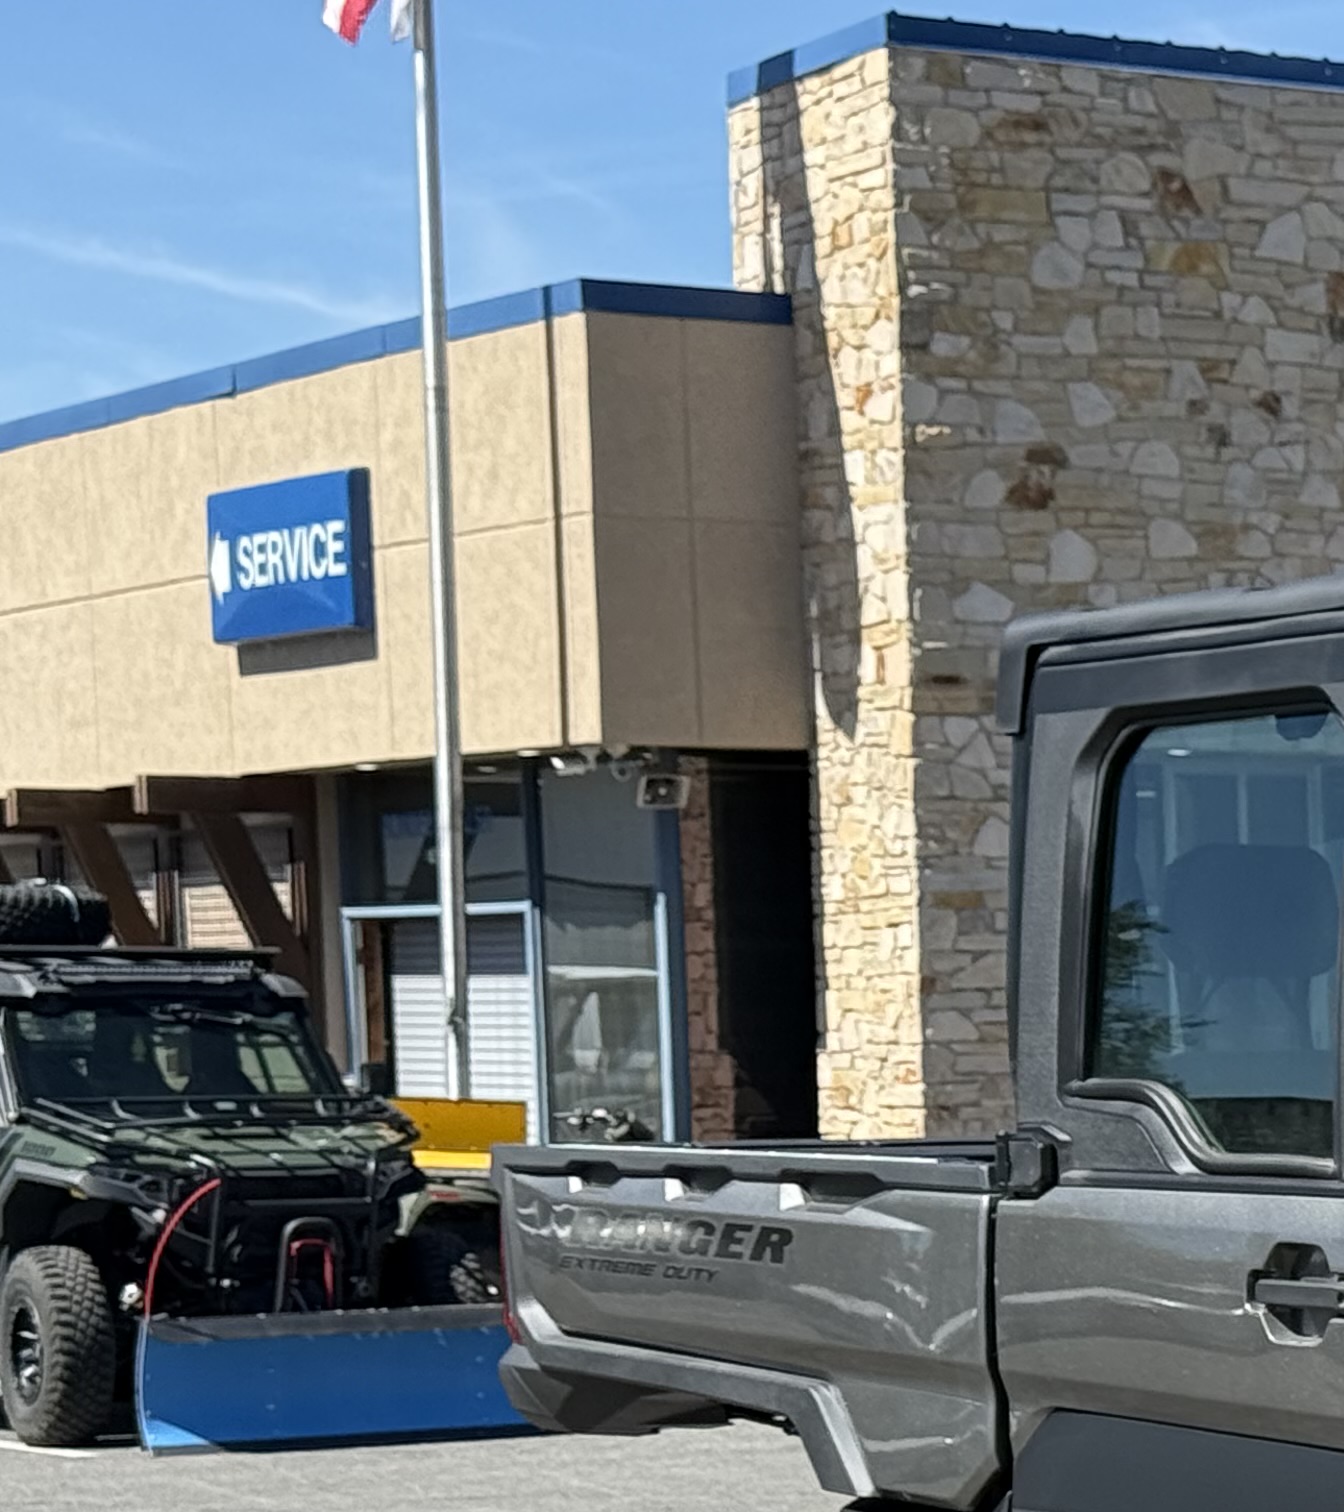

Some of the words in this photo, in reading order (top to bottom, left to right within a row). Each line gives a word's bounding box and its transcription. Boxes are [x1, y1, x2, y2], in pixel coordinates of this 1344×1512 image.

[237, 519, 348, 591] SERVICE
[560, 1207, 794, 1264] RANGER
[558, 1255, 655, 1277] EXTREME
[662, 1264, 720, 1283] DUTY
